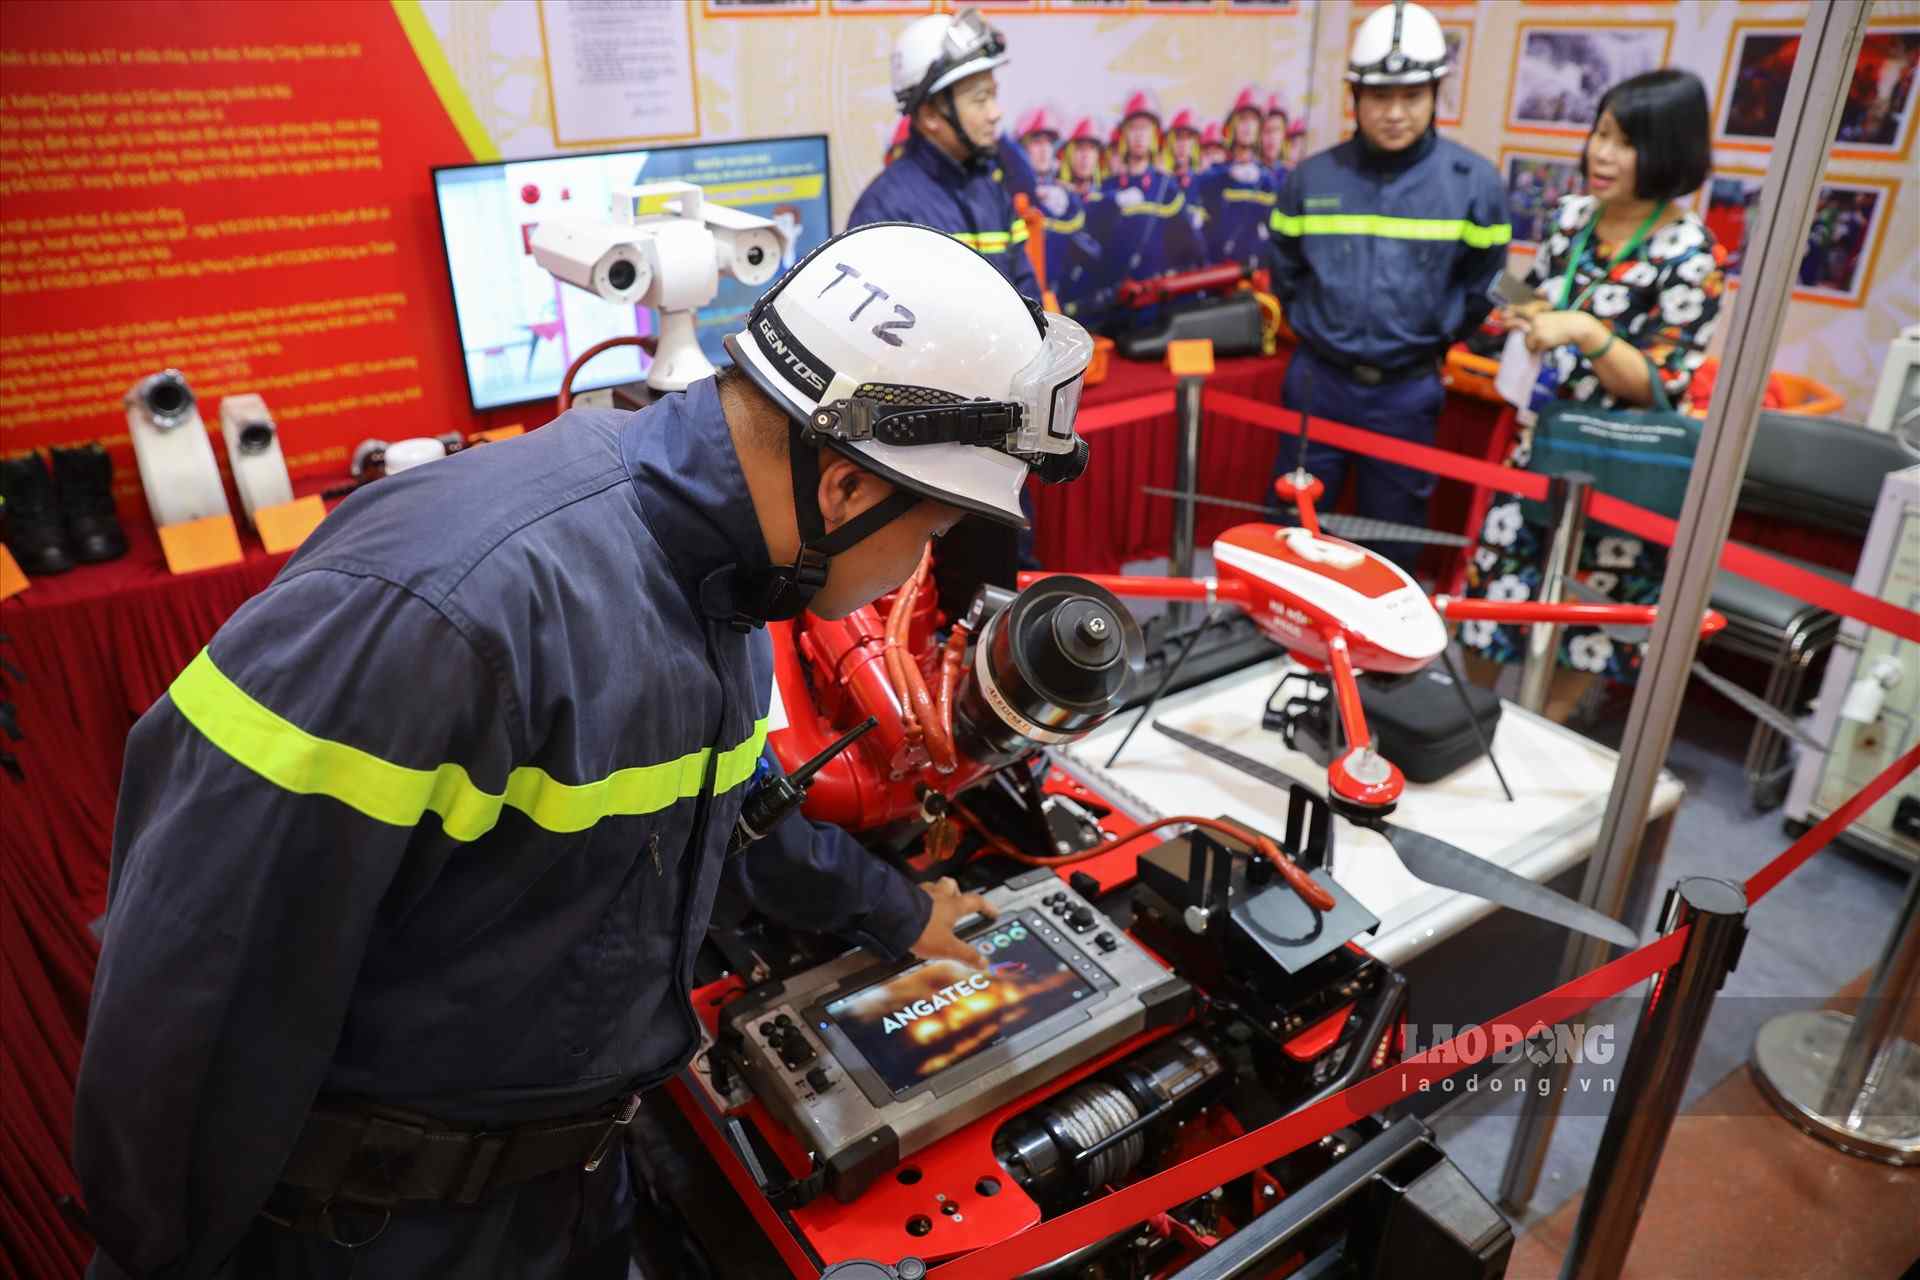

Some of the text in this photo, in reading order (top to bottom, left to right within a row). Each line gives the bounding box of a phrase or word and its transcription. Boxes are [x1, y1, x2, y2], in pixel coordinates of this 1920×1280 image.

[817, 262, 916, 347] TT2
[759, 318, 826, 391] GENTOS
[882, 973, 991, 1034] ANGATEC
